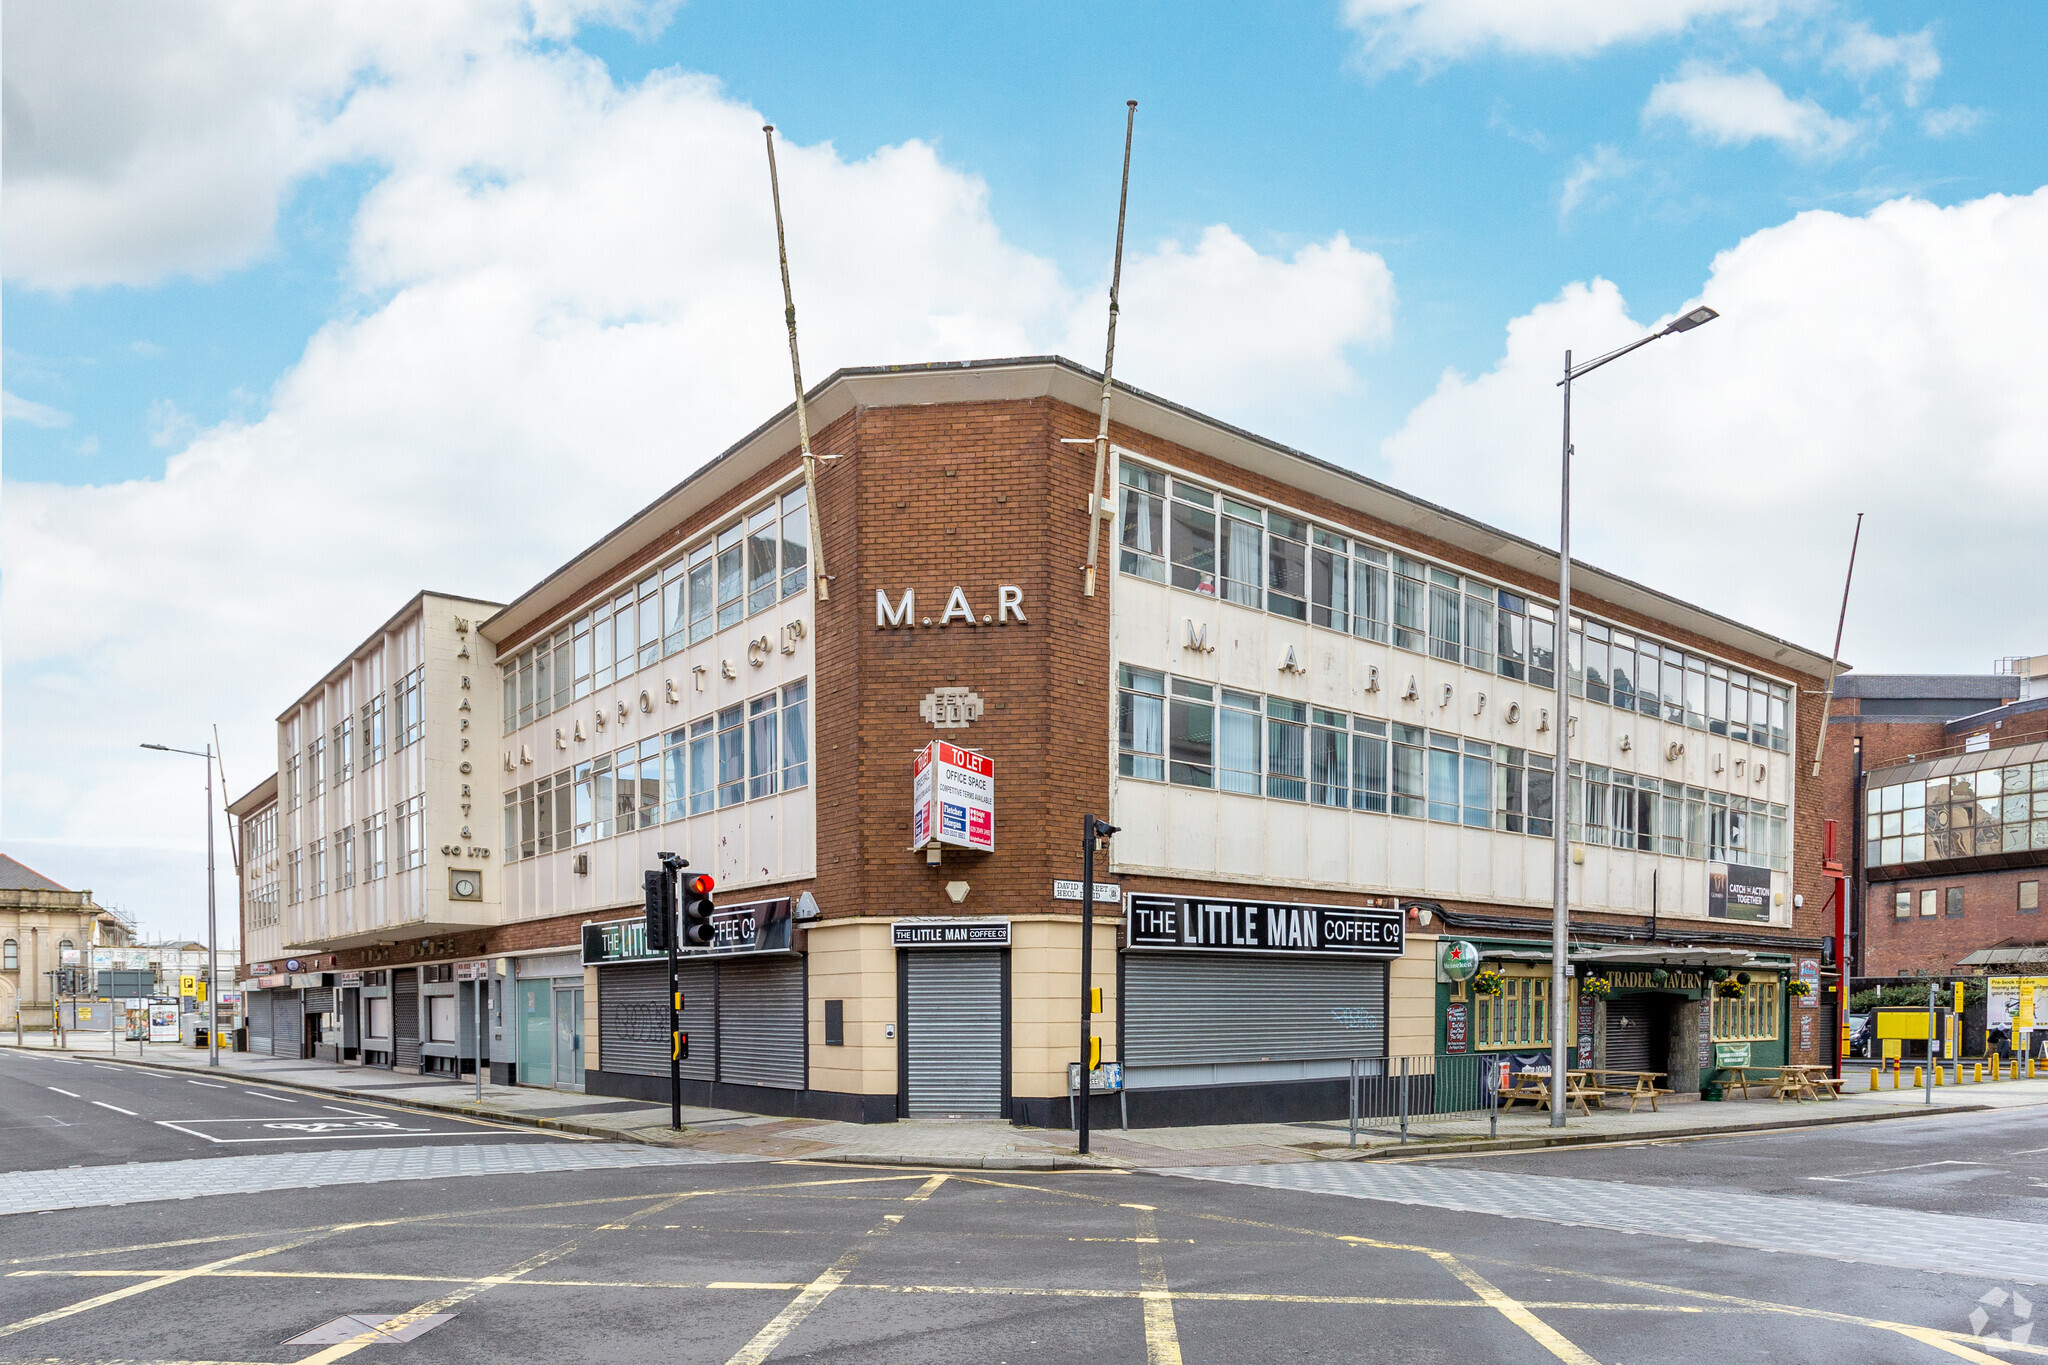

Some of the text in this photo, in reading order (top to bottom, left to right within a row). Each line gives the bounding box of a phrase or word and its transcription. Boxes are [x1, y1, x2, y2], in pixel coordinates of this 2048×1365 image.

[555, 664, 707, 750] RAPPORT
[721, 659, 736, 680] &
[458, 675, 473, 817] RAPPORT
[952, 748, 984, 773] TO LET
[946, 769, 967, 785] OFFICE
[968, 775, 987, 791] SPACE
[940, 783, 962, 797] COMPETITIVE
[962, 789, 975, 801] TERMS
[975, 792, 992, 806] AVAILABLE
[944, 804, 963, 817] Fletcher
[944, 817, 962, 830] Morgan
[467, 846, 492, 859] LTD
[1057, 882, 1079, 891] DAVID
[1730, 884, 1746, 894] CATCH
[1752, 886, 1770, 897] ACTION
[1057, 890, 1077, 898] HEOL
[1737, 894, 1763, 905] TOGETHER
[1136, 909, 1176, 934] THE
[1183, 903, 1259, 945] LITTLE
[1267, 907, 1318, 948] MAN
[1324, 920, 1380, 942] COFFEE
[602, 933, 620, 951] THE
[712, 919, 740, 942] FFEE
[896, 931, 911, 939] THE
[912, 929, 942, 941] LITTLE
[945, 928, 968, 941] MAN
[969, 930, 997, 938] COFFEE
[1444, 961, 1473, 969] Heineken
[1664, 972, 1701, 989] TAVERN
